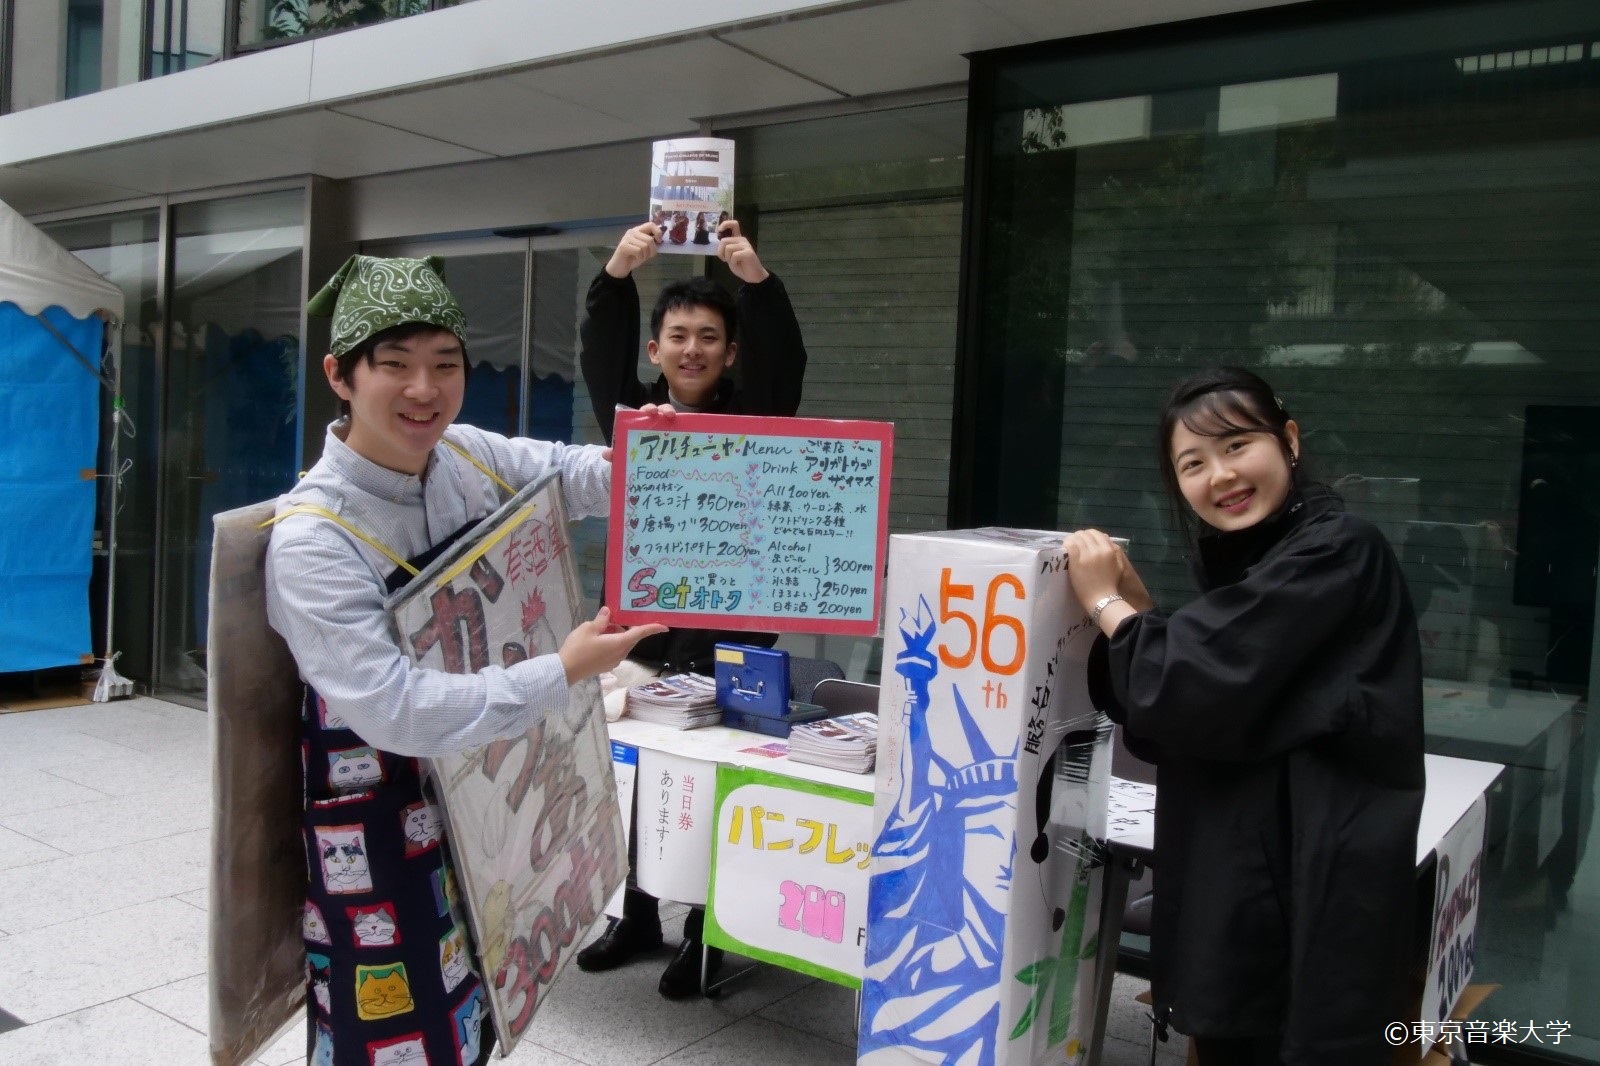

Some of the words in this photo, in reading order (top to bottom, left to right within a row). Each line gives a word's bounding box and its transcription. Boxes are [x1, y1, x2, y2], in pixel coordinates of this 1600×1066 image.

[742, 440, 792, 456] Menu
[637, 466, 670, 479] Food
[762, 462, 798, 474] Drink
[699, 517, 747, 533] 300yen
[768, 541, 811, 552] Alcohol
[628, 567, 692, 609] Set
[818, 601, 862, 616] 200yen
[938, 567, 1026, 676] 56
[982, 679, 1008, 709] th
[678, 774, 695, 831] 当日券
